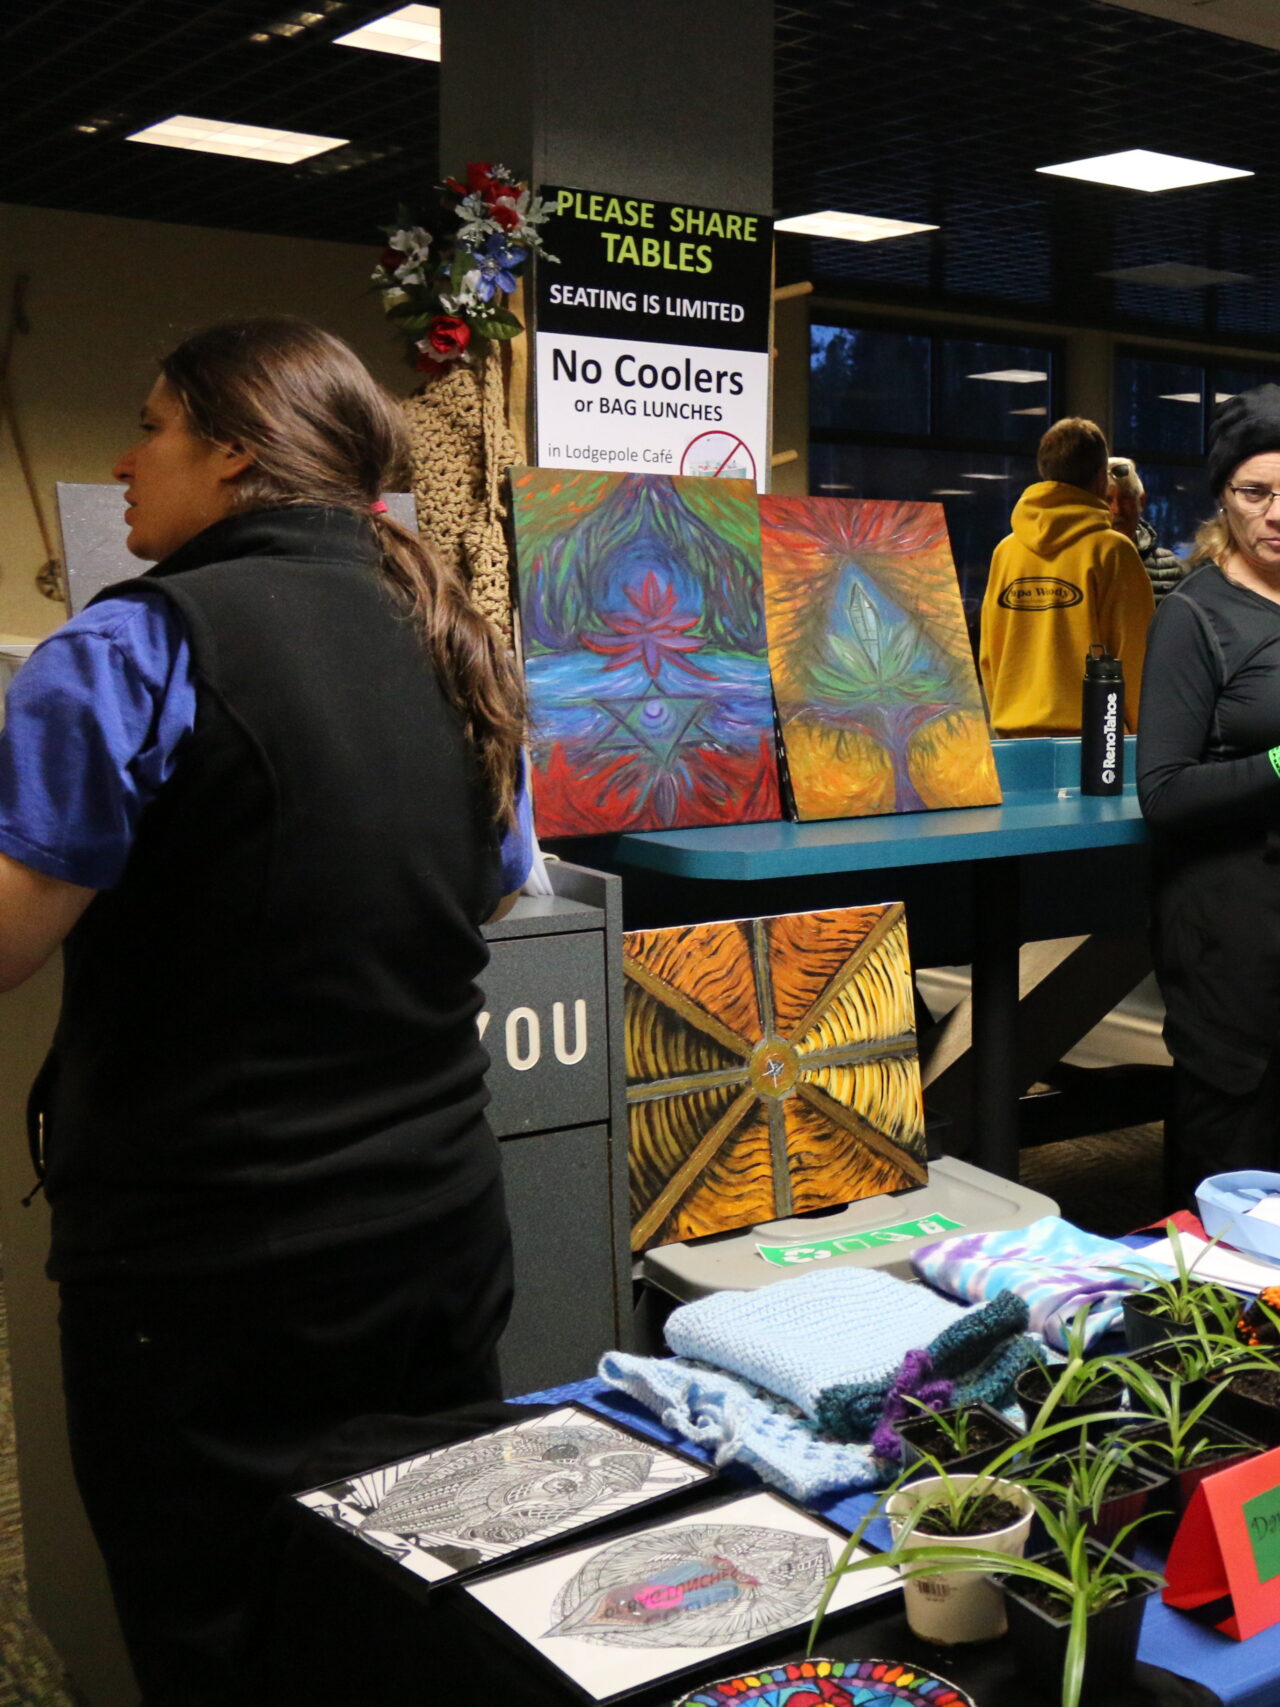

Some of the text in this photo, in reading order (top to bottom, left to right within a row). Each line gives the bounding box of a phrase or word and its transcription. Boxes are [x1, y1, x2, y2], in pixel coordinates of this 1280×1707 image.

[556, 189, 758, 242] PLEASE SHARE
[601, 231, 713, 274] TABLES
[549, 284, 745, 323] SEATING IS LIMITED
[552, 348, 744, 396] No Coolers
[574, 397, 723, 422] or BAG LUNCHES
[548, 443, 673, 464] in Lodgepole Café
[1102, 692, 1117, 769] RenoTahoe
